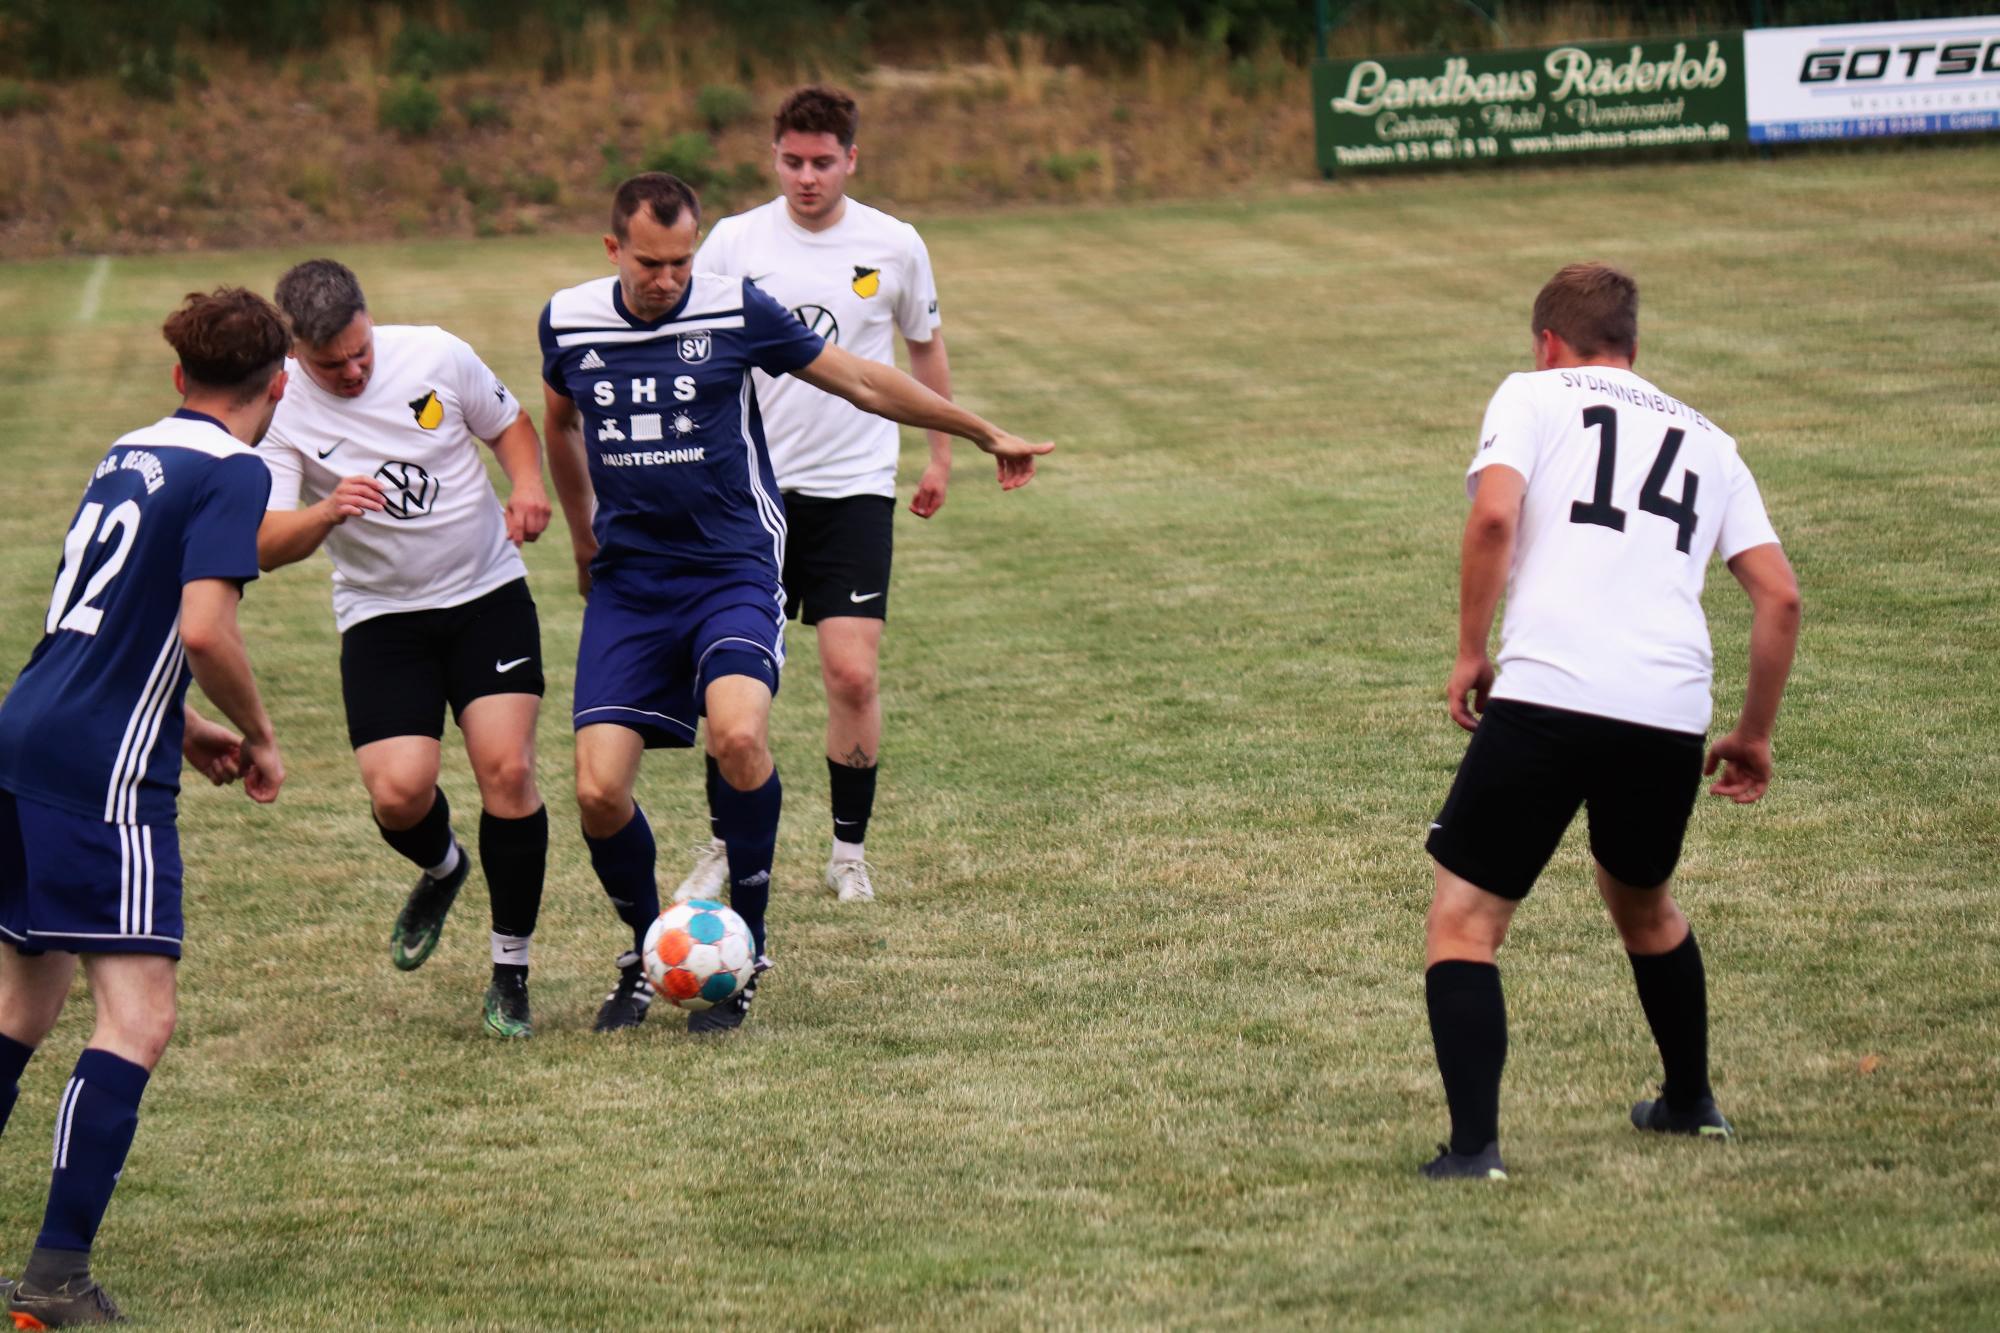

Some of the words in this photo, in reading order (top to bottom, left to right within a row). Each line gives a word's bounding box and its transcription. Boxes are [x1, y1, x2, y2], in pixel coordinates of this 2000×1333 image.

[1331, 57, 1537, 116] Landhaus
[682, 339, 706, 359] SV
[1561, 372, 1582, 388] SV
[600, 447, 705, 467] HAUSTECHNIK
[1569, 404, 1699, 555] 14
[46, 499, 141, 635] 12
